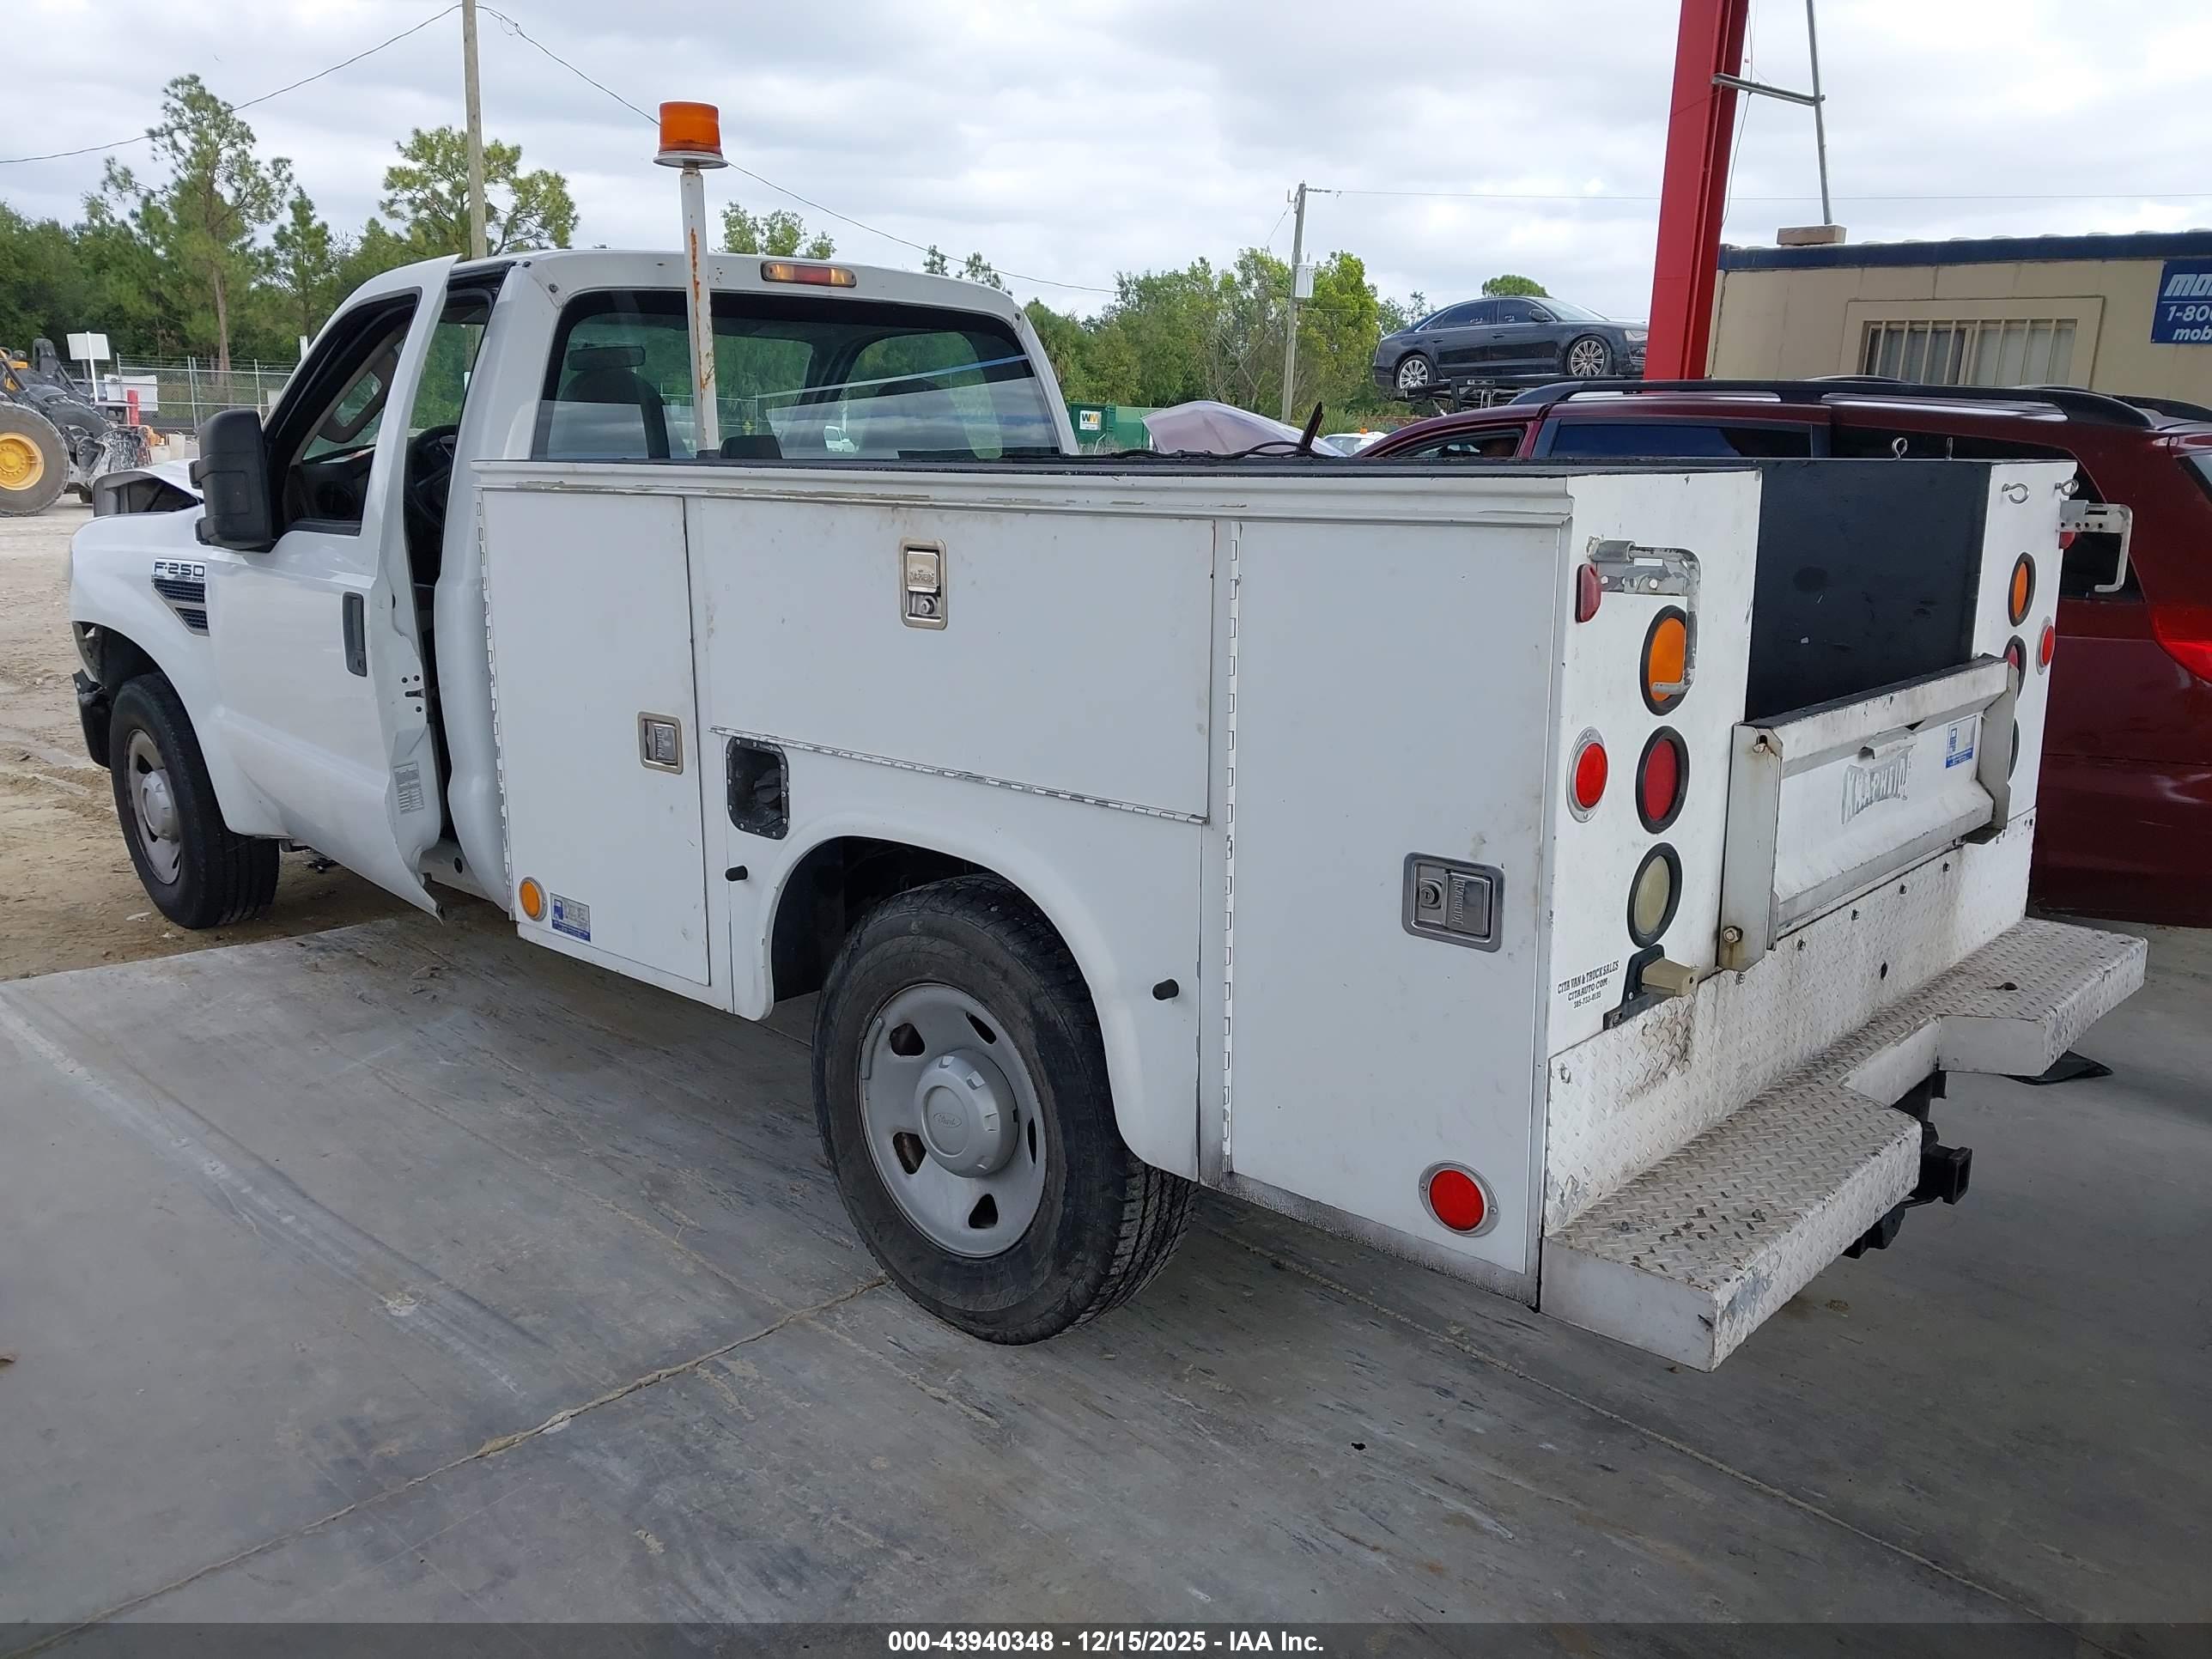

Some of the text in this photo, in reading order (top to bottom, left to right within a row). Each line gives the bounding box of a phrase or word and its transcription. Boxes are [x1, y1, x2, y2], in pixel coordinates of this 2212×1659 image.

[2166, 305, 2212, 321] 1-80
[155, 562, 205, 577] F-250
[1558, 980, 1570, 994] CITA
[1571, 975, 1581, 988] VAN
[1586, 966, 1603, 982] TRUCK
[1603, 960, 1619, 975] SALES
